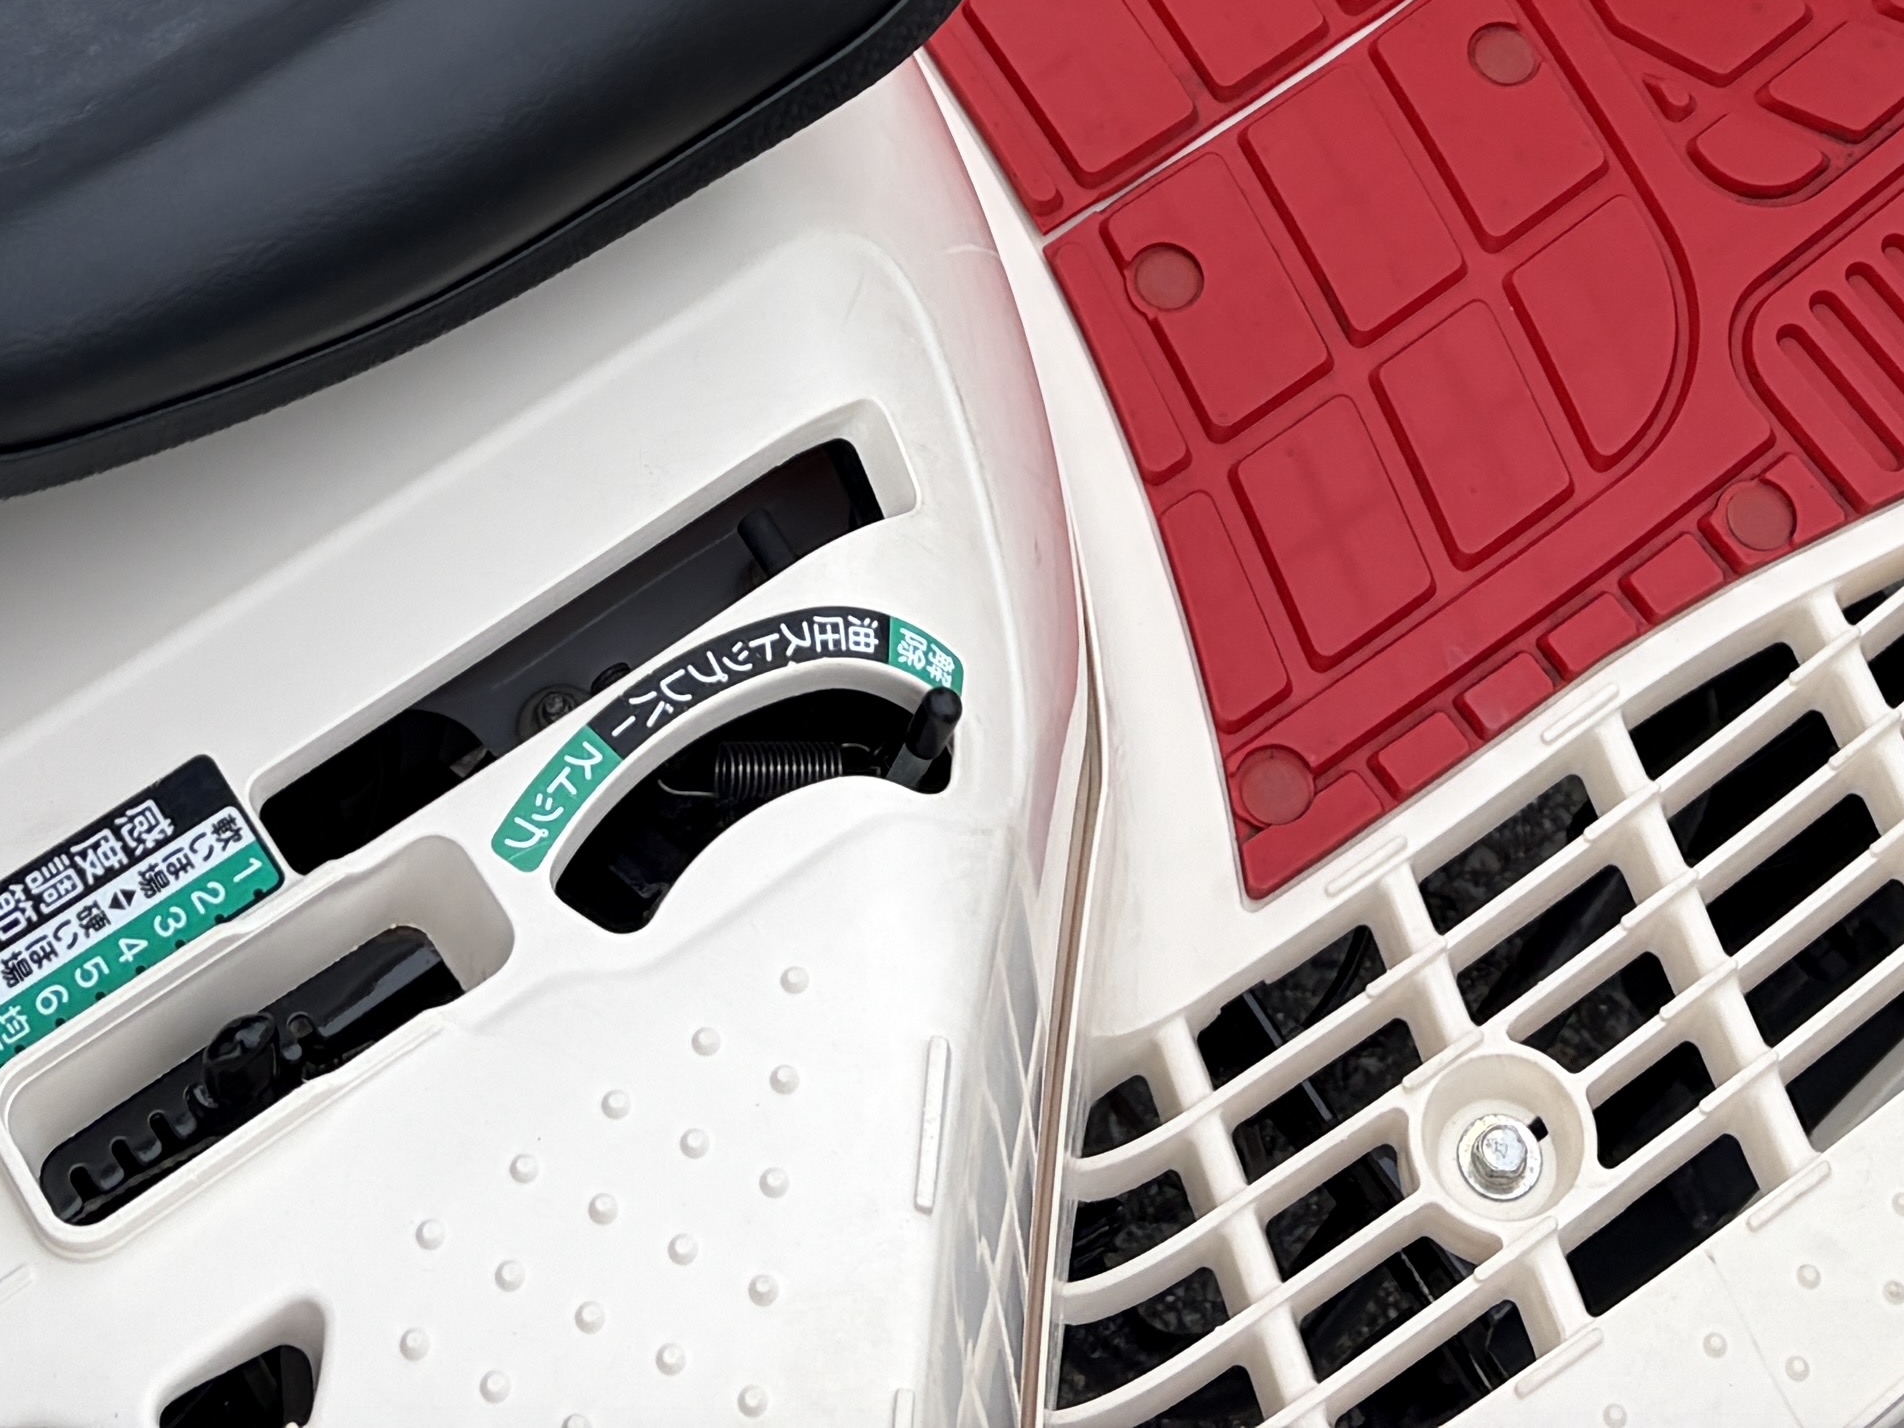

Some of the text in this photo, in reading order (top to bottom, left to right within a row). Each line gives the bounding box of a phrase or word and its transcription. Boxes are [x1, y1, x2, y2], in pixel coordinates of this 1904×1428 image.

[896, 627, 956, 688] 解除
[612, 614, 879, 737] 油圧ストップレバー
[504, 740, 604, 850] ストップ
[138, 814, 244, 898] 軟いほ場
[232, 858, 262, 883] 1
[191, 882, 226, 914] 2
[153, 907, 187, 937] 3
[118, 937, 148, 962] 4
[75, 958, 109, 989] 5
[36, 985, 69, 1016] 6
